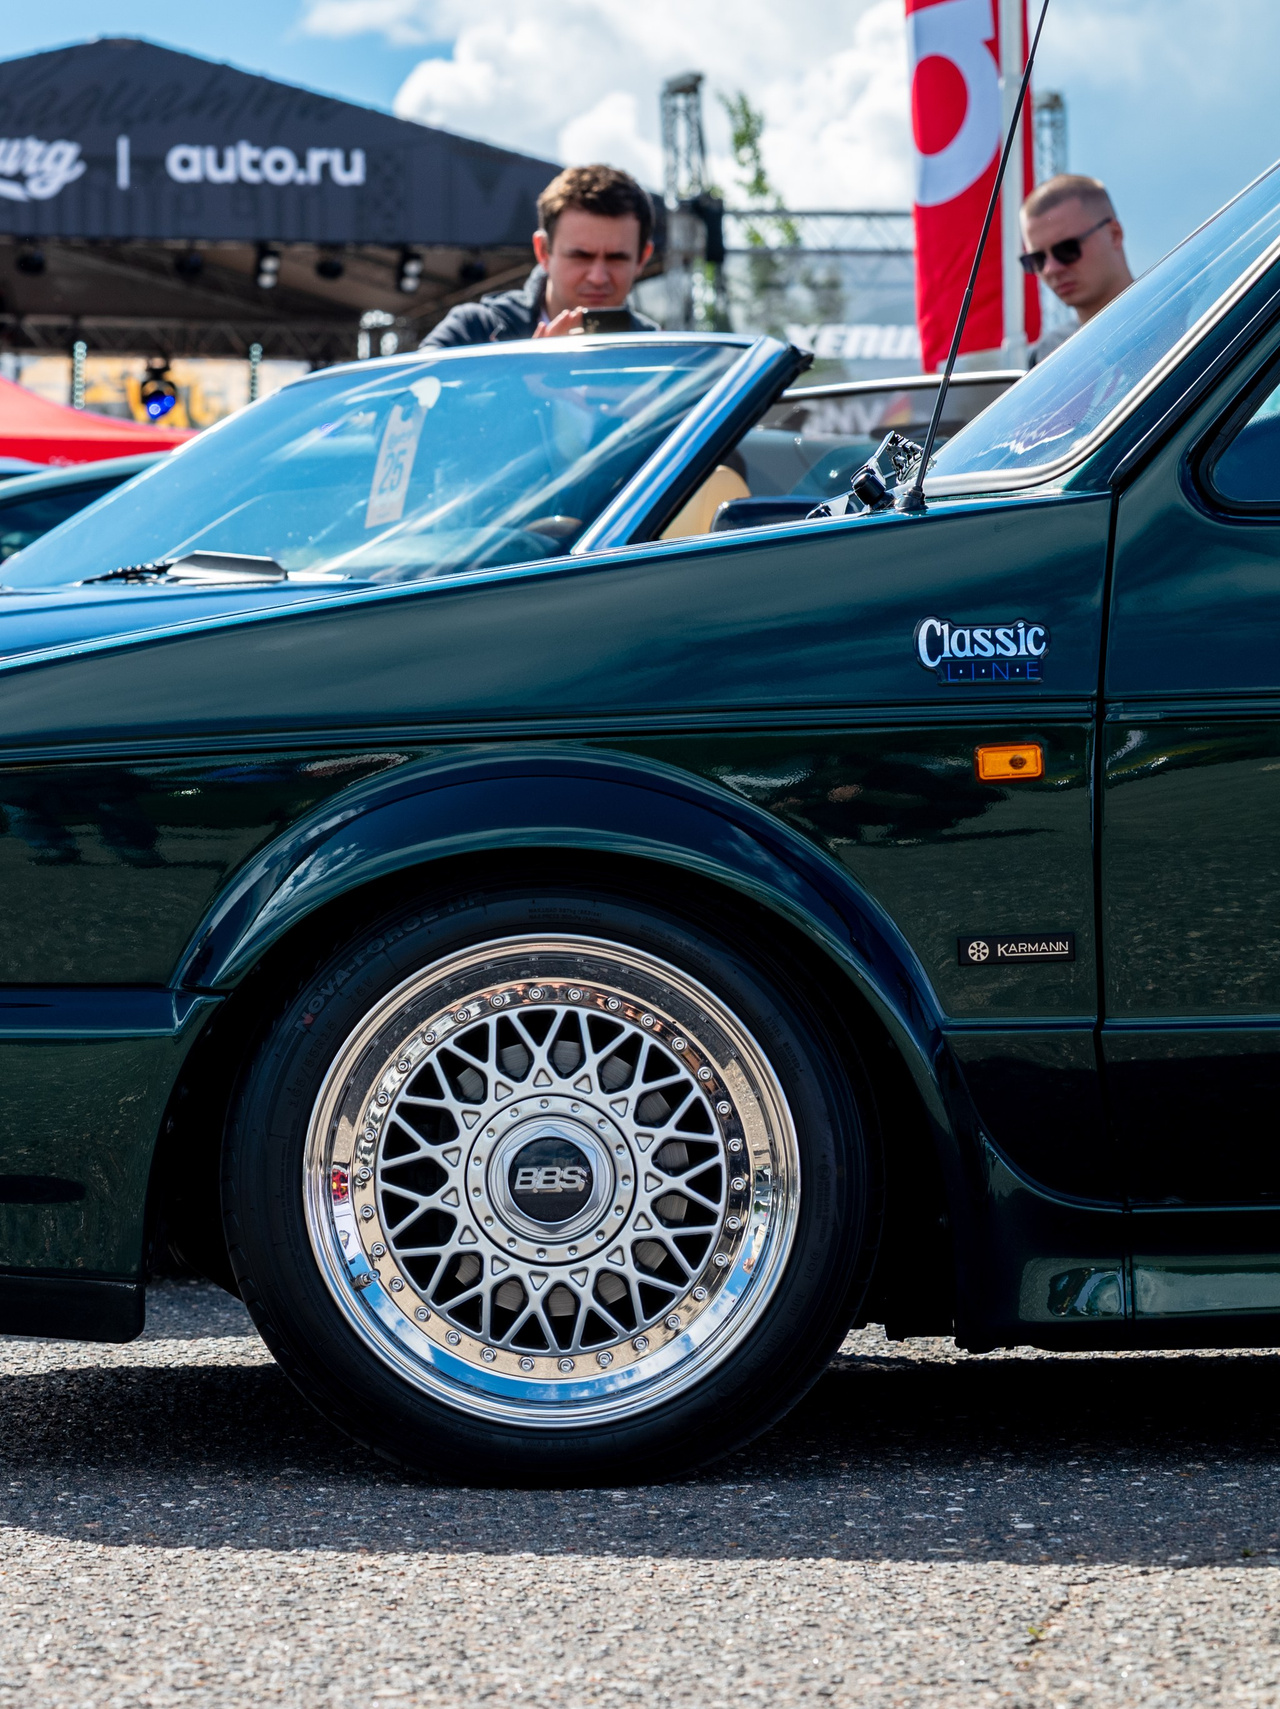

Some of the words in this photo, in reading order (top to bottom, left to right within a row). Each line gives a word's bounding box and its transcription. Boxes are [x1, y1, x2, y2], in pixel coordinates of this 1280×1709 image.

[166, 139, 364, 187] auto.ru
[918, 618, 1046, 668] Classic
[997, 941, 1069, 957] KARMANN
[514, 1166, 587, 1193] BBS
